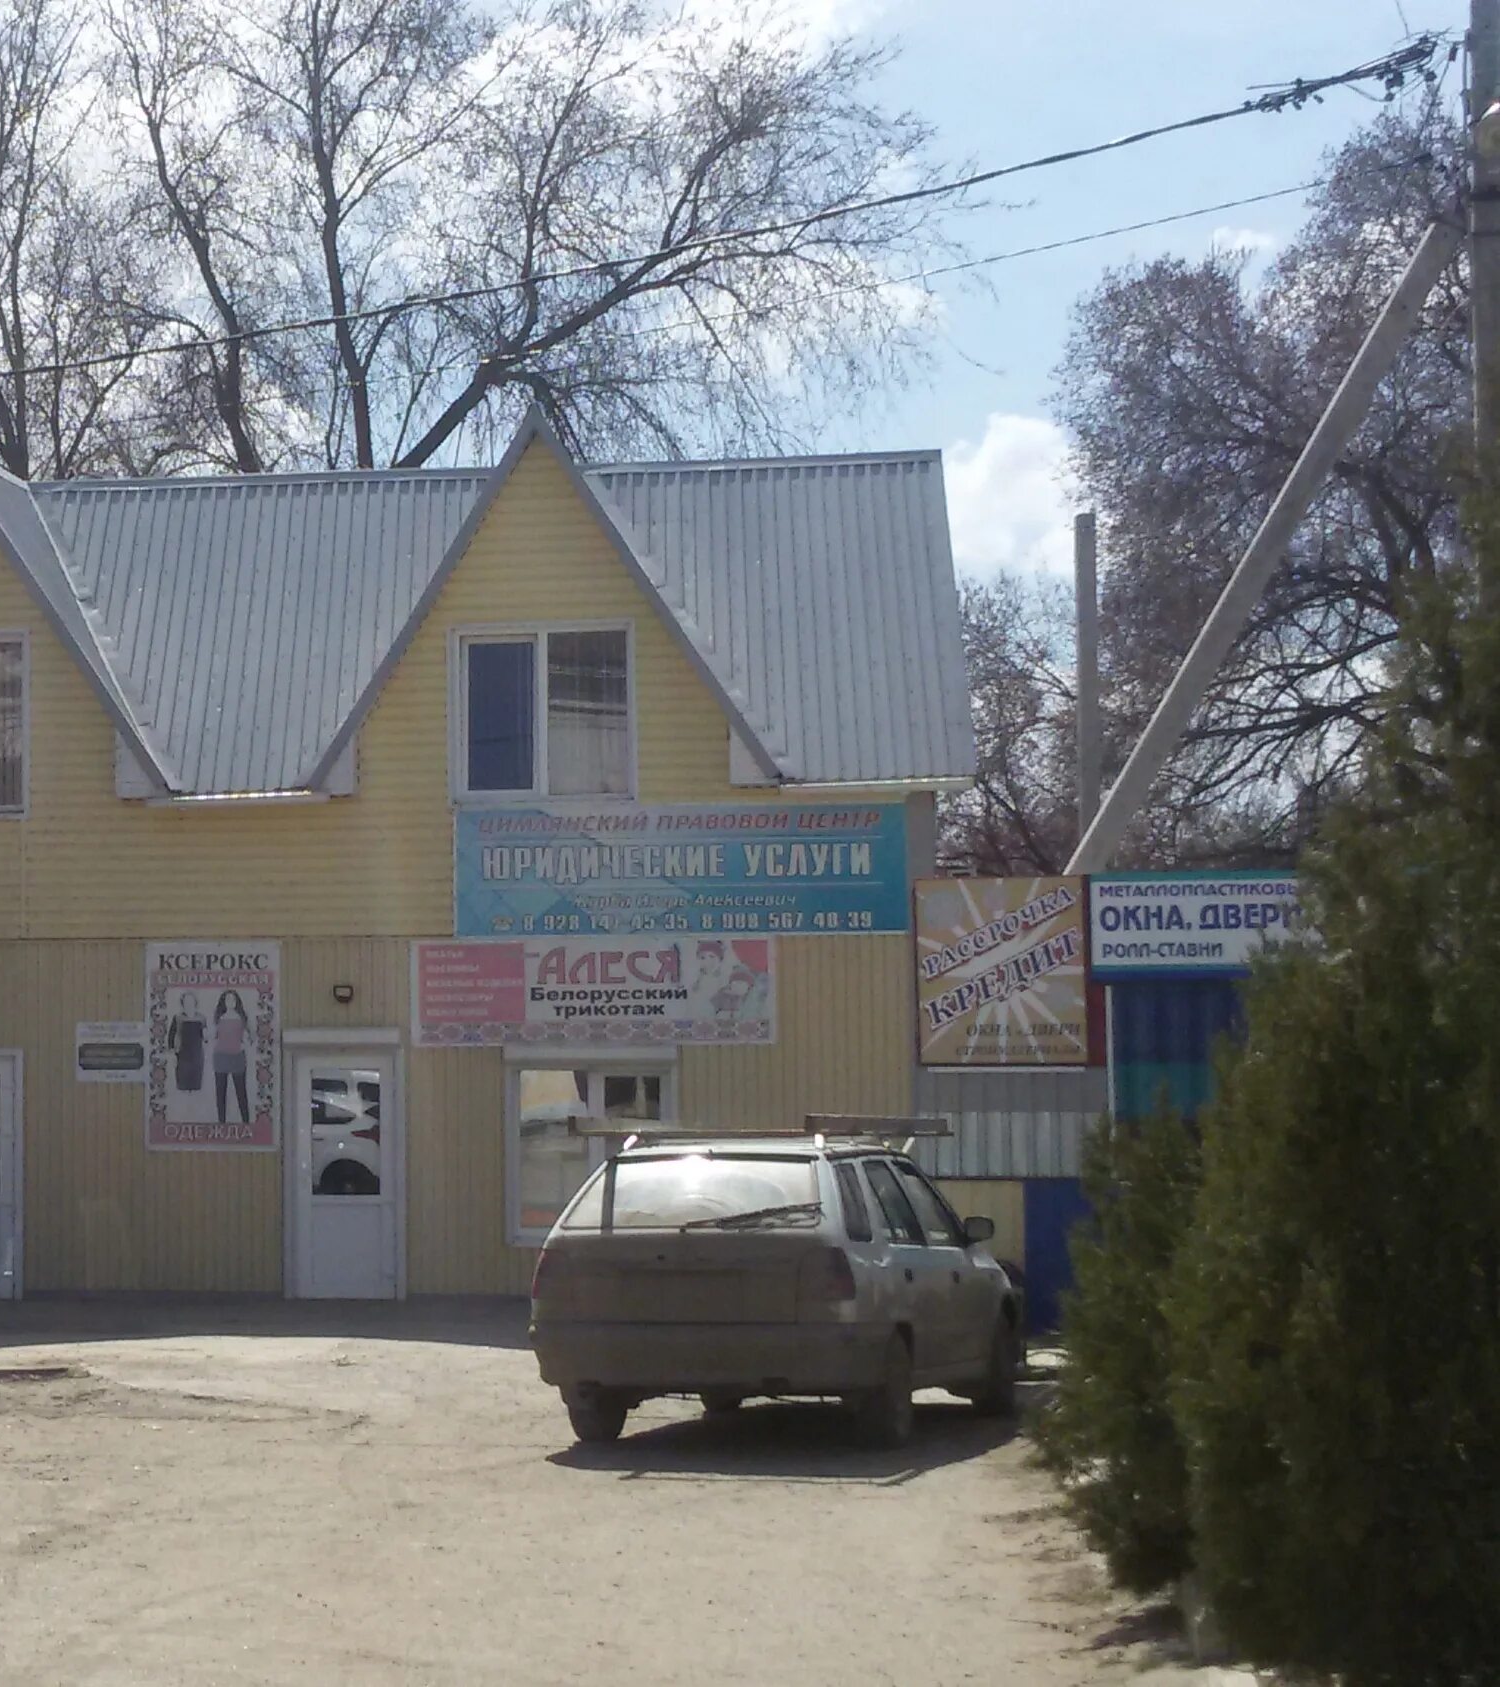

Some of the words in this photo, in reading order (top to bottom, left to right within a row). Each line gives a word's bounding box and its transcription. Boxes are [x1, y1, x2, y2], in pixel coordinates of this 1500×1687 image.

[478, 811, 648, 834] ЦИМЛЯНСКИЙ
[657, 811, 789, 831] ПРАВОВОЙ
[797, 811, 881, 830] ЦЕНТР
[482, 844, 725, 885] ЮРИДИЧЕСКИЕ
[742, 842, 871, 877] УСЛУГИ
[924, 885, 1076, 980] РАССРОЧКА
[1102, 942, 1223, 958] РОЛЛ-СТАВНИ
[159, 953, 269, 970] КСЕРОКС
[926, 928, 1083, 1030] КРЕДИТ
[530, 984, 688, 1001] Белорусский
[553, 1002, 666, 1019] трикотаж
[164, 1124, 253, 1141] ОДЕЖДА
